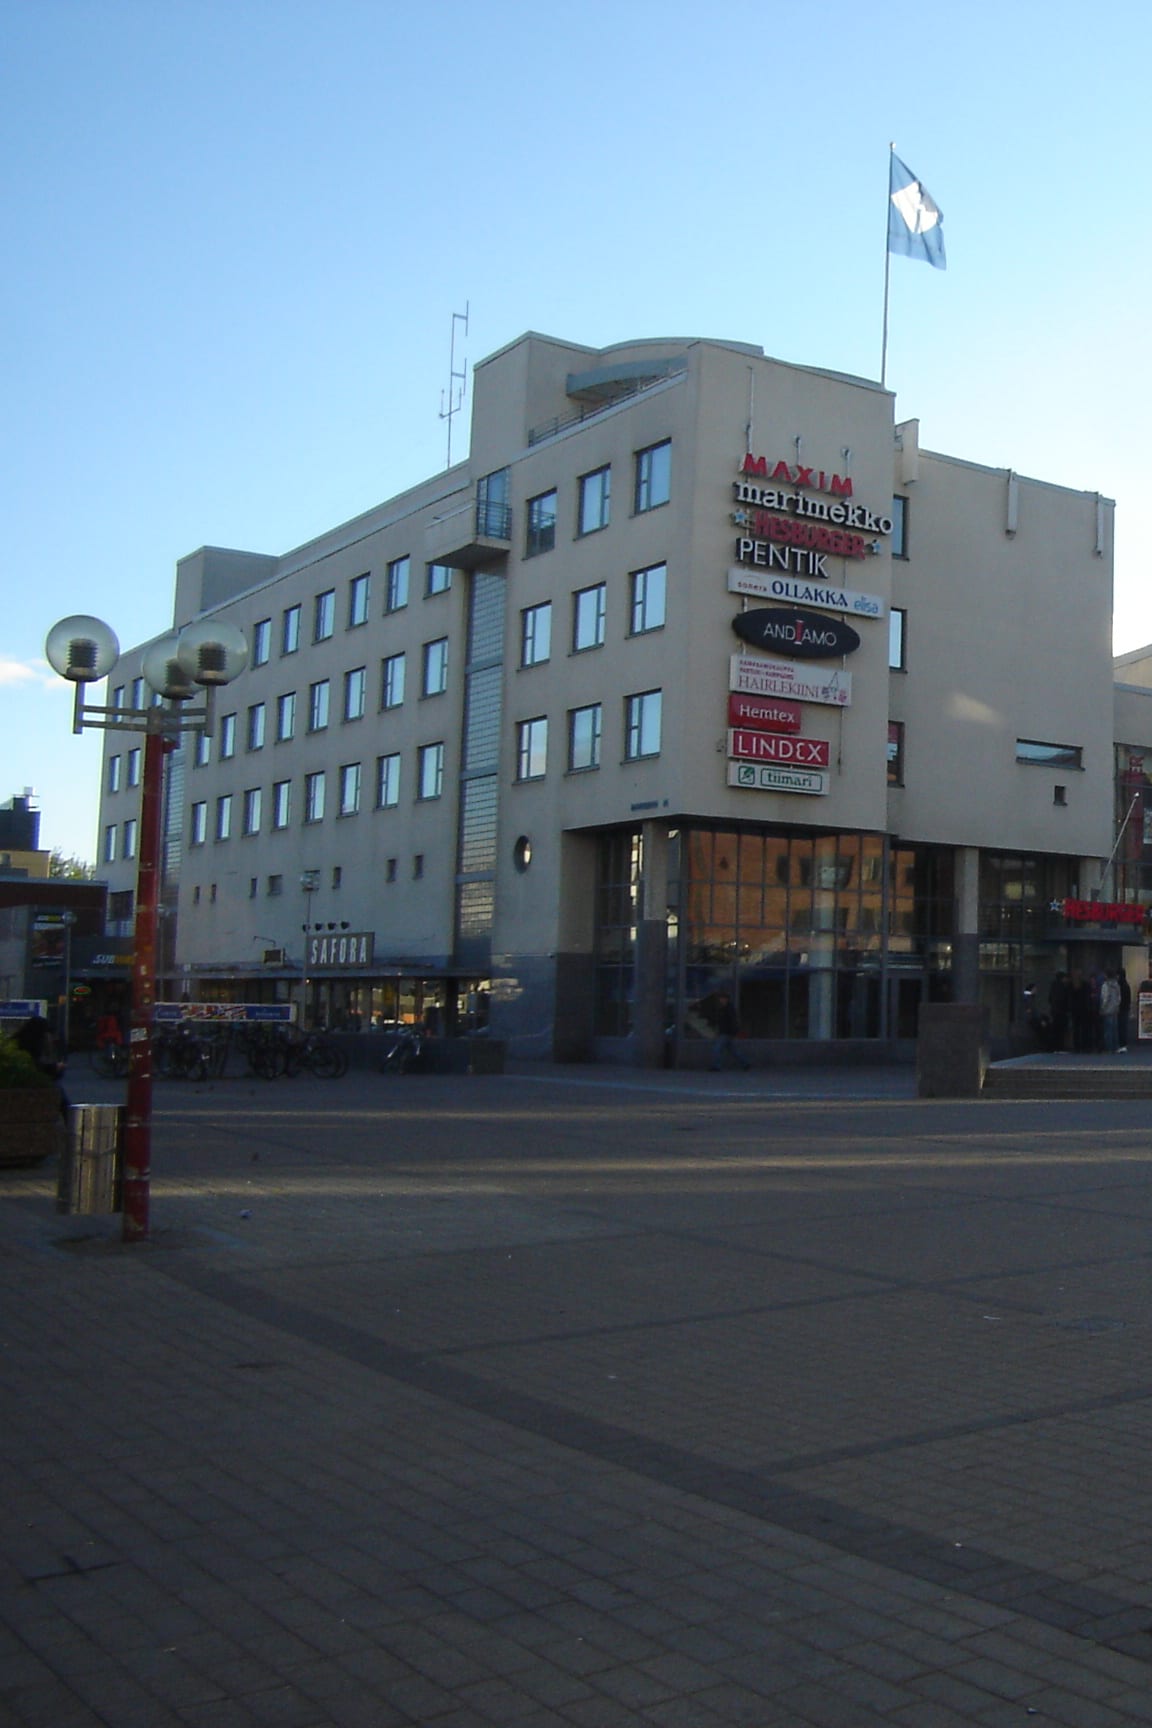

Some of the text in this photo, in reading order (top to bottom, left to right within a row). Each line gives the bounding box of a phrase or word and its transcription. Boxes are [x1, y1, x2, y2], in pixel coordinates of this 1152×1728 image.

[741, 453, 853, 497] MAXIM
[736, 481, 893, 535] marimekko
[754, 511, 866, 560] HESBURGER
[739, 538, 829, 578] PENTIK
[771, 580, 848, 607] OLLAKKA
[764, 619, 837, 647] ANDIAMO
[739, 704, 796, 723] Hemtex
[738, 735, 823, 762] LINDEX
[767, 771, 813, 788] tiimari
[311, 936, 367, 965] SAFORA
